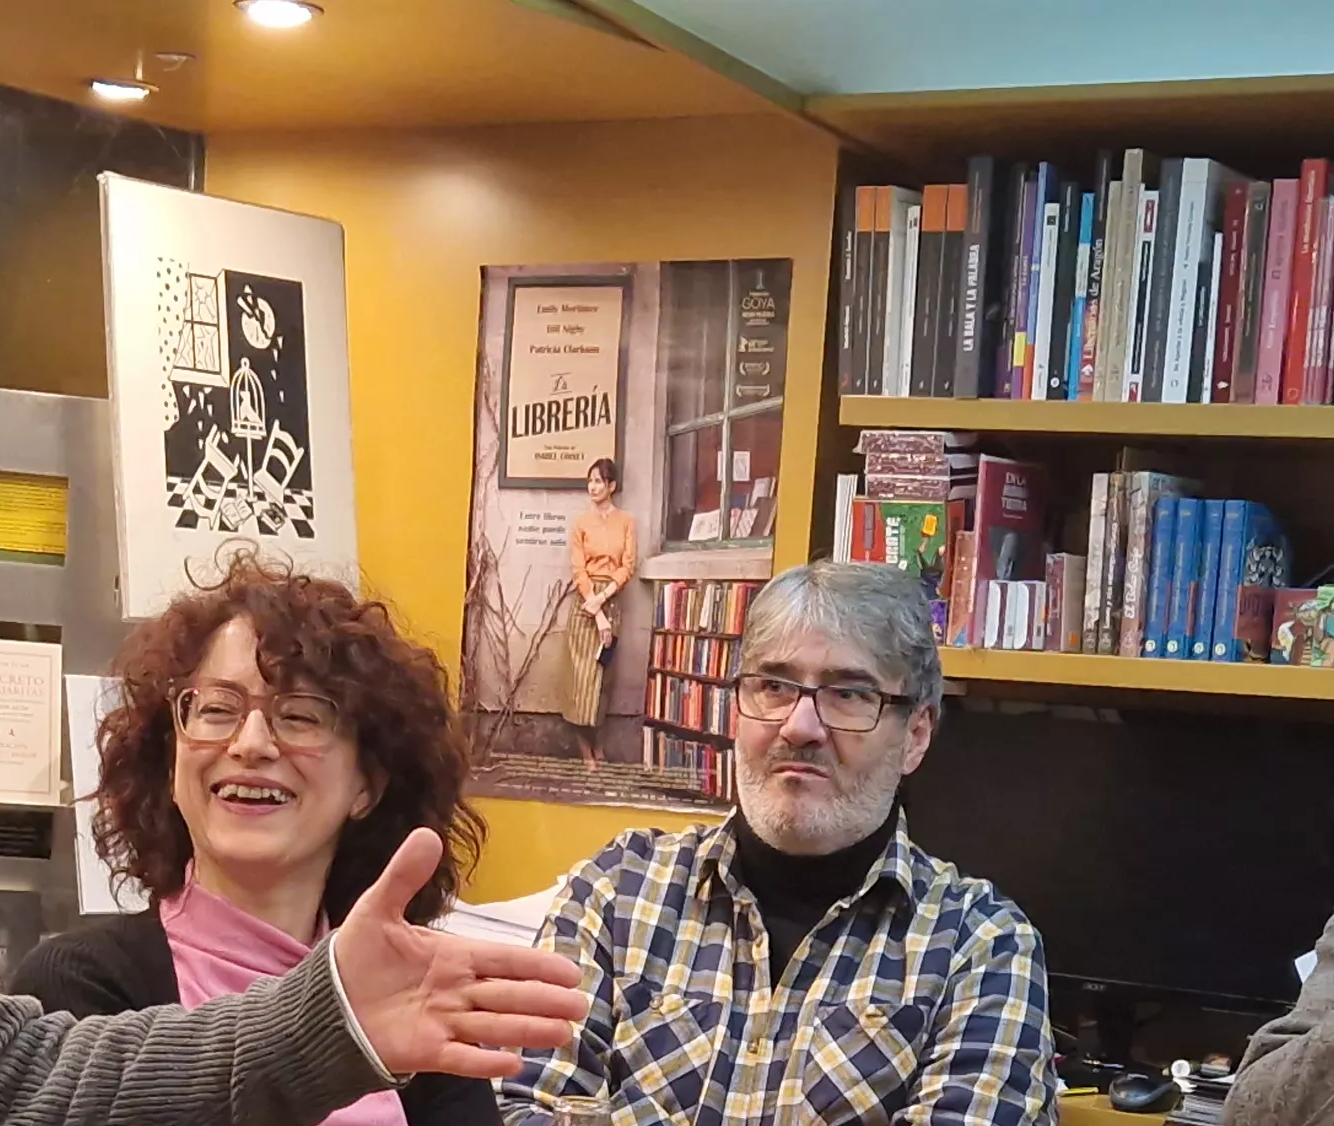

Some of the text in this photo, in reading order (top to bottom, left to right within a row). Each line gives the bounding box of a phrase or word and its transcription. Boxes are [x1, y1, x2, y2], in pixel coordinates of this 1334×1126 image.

[1088, 239, 1104, 297] de Aragón
[741, 296, 776, 310] GOYA
[966, 289, 978, 300] LA
[964, 312, 976, 336] BALA
[963, 338, 974, 351] LA
[511, 384, 612, 439] LIBRERÍA
